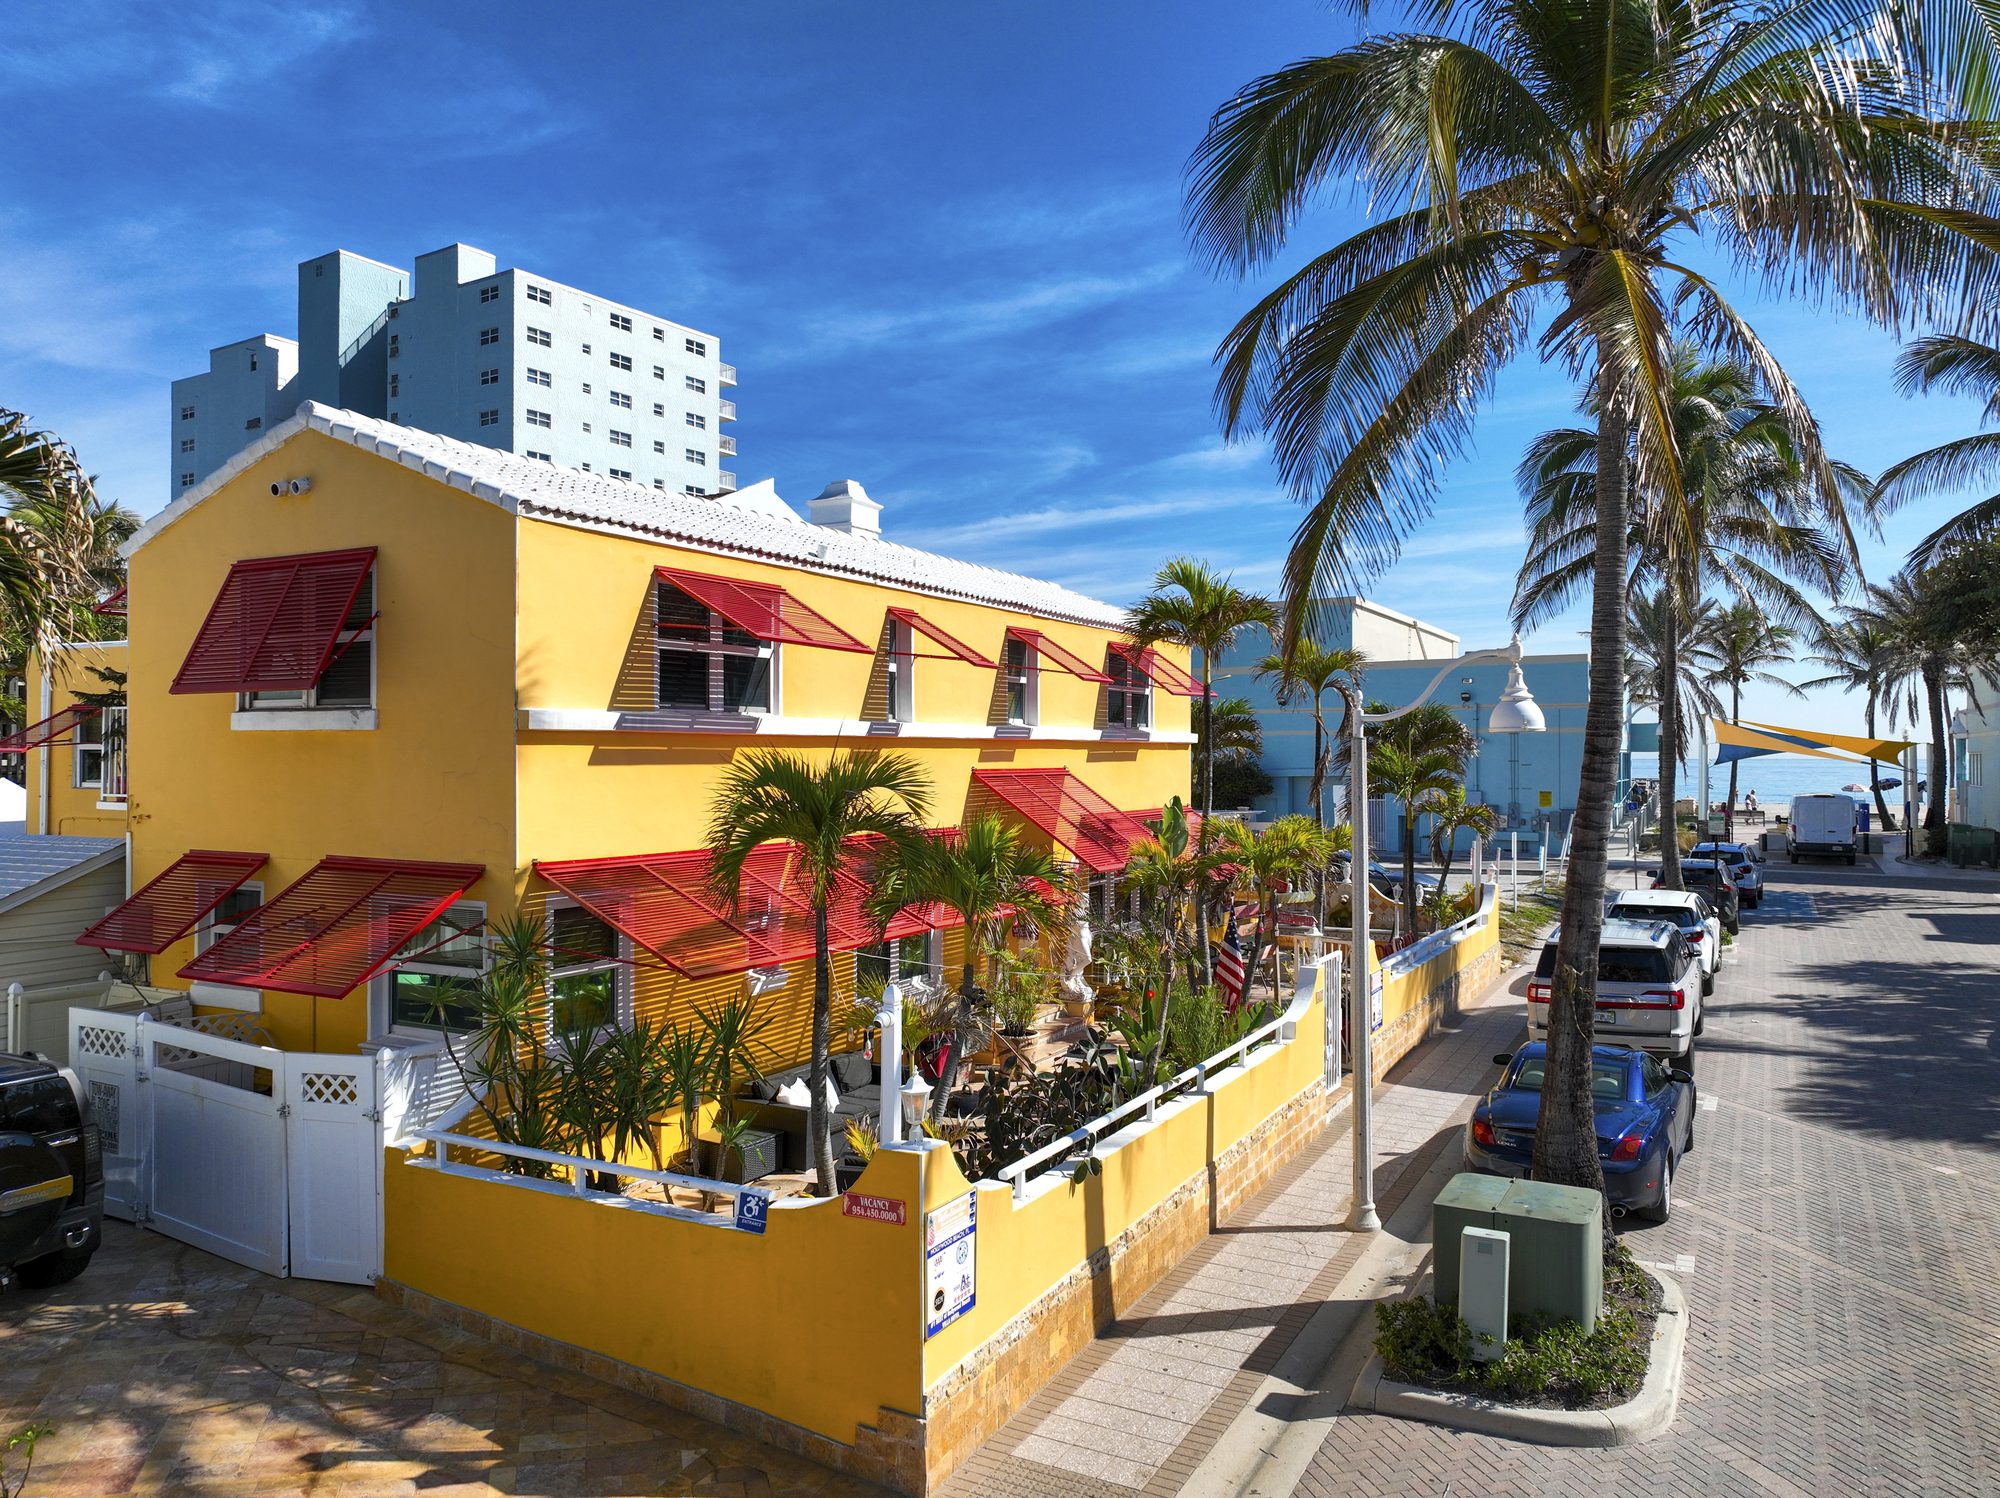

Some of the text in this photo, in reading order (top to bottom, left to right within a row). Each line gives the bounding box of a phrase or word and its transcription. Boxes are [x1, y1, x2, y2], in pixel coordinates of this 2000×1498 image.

[860, 1196, 890, 1210] VACANCY
[851, 1205, 898, 1222] 954.450.0000
[741, 1218, 762, 1228] ENTRANCE
